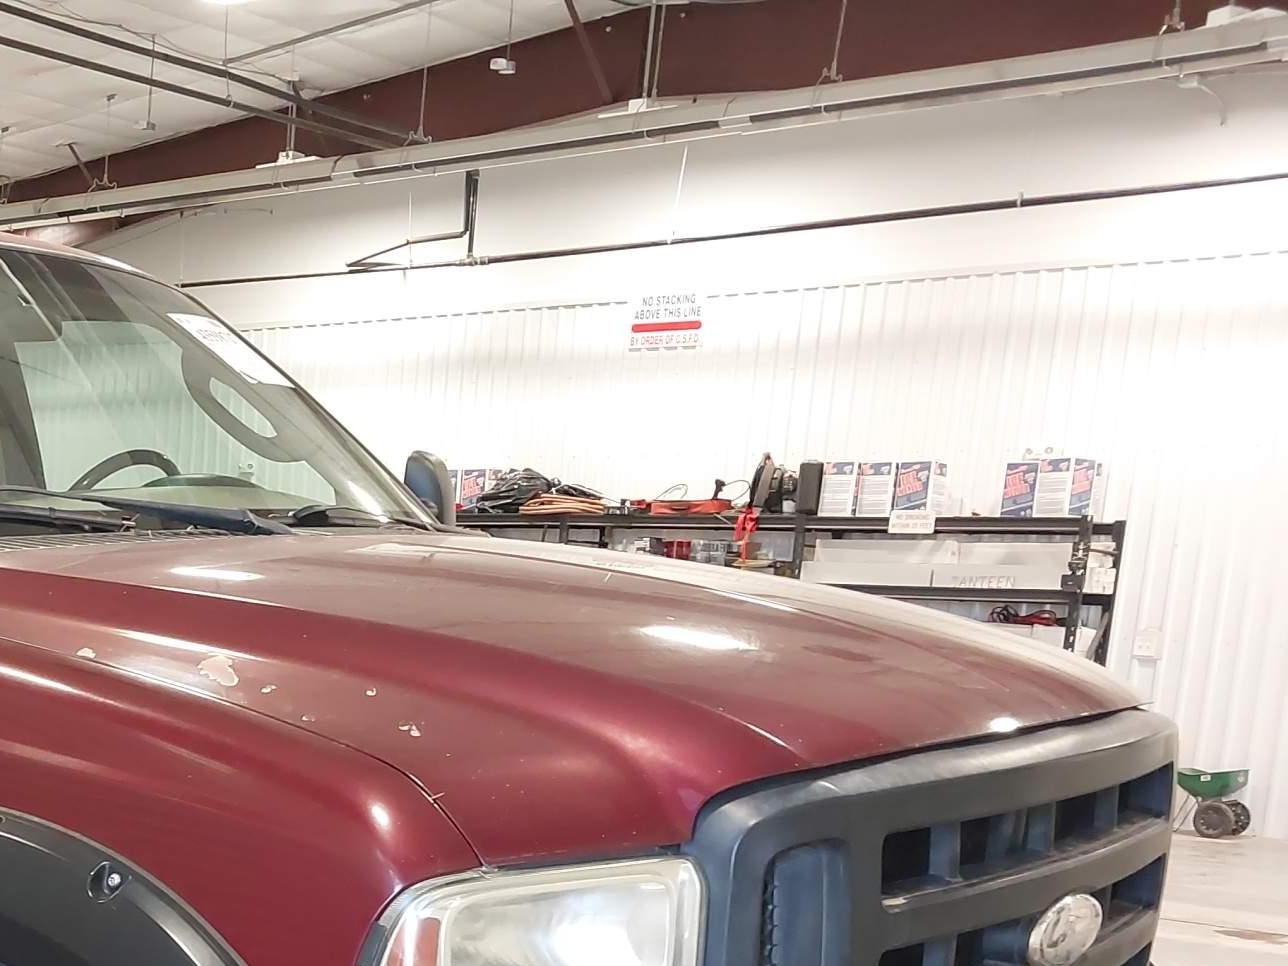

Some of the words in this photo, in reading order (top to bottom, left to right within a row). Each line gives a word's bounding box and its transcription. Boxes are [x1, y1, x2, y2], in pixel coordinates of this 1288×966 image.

[642, 296, 654, 307] NO
[656, 293, 696, 306] STACKING
[634, 308, 661, 320] ABOVE
[663, 307, 681, 319] THIS
[683, 305, 702, 318] LINE
[640, 335, 664, 346] ORDER
[665, 334, 674, 345] OF
